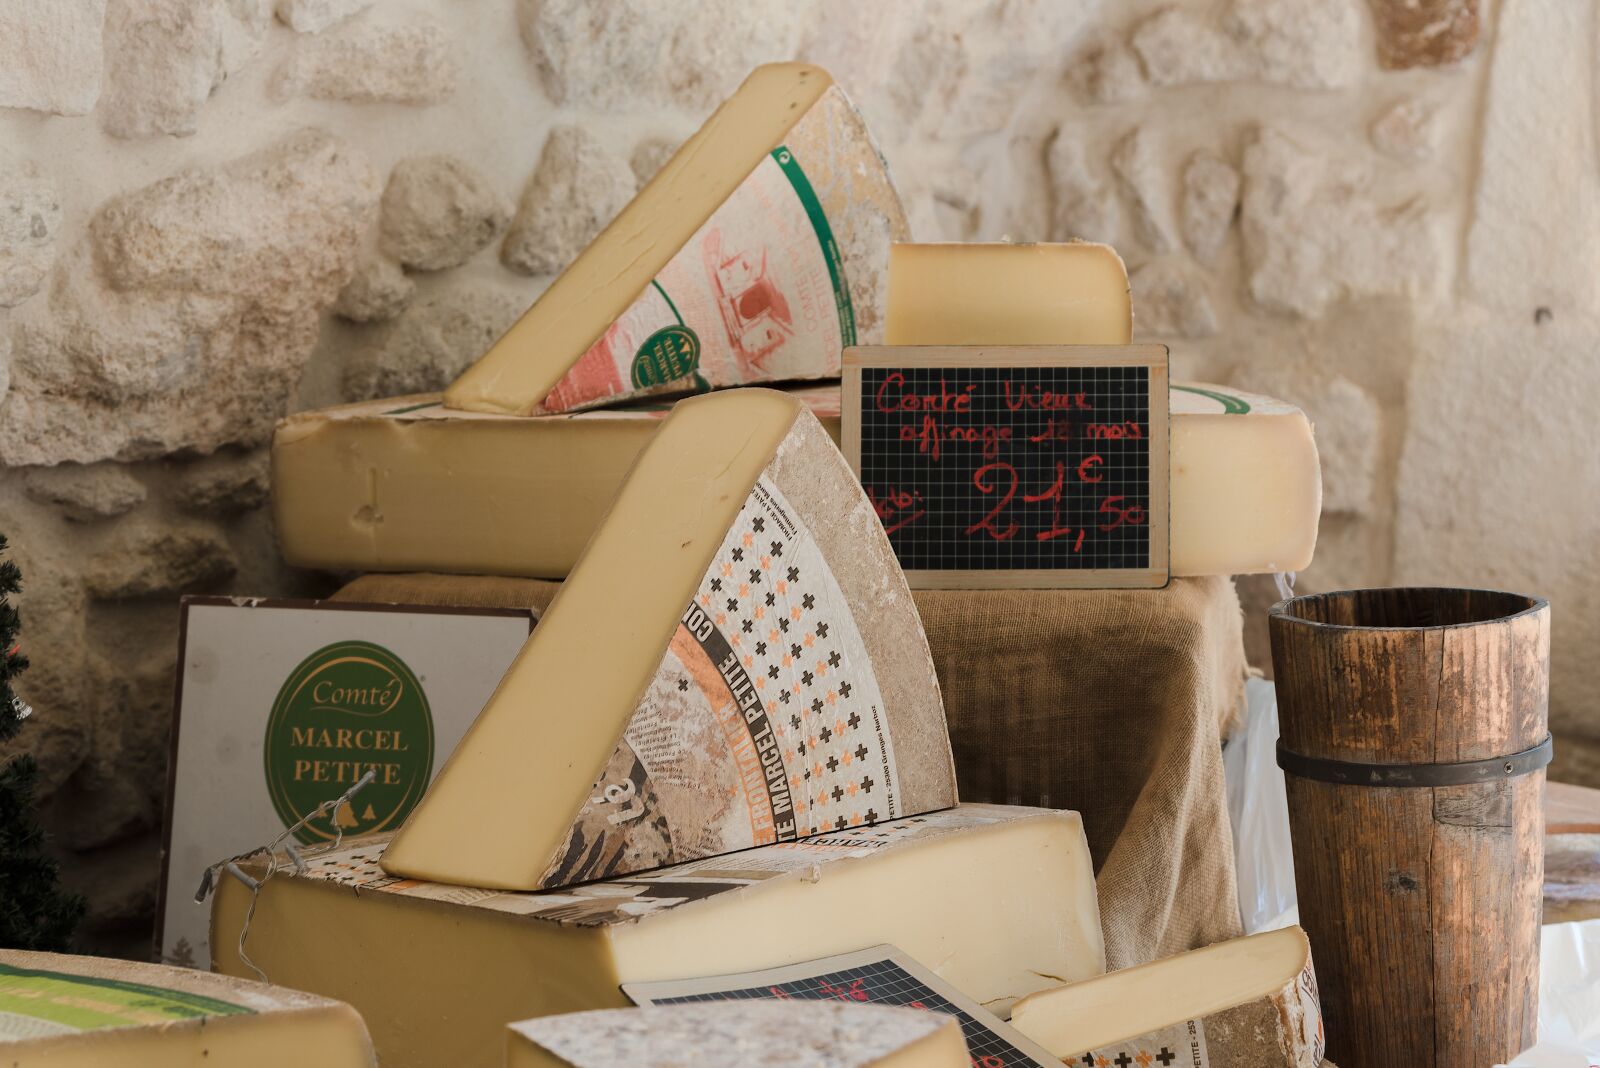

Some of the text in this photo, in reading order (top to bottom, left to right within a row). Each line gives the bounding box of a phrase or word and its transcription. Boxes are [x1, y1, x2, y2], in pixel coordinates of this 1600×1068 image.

[1087, 420, 1142, 441] mois
[312, 678, 402, 706] Comté
[718, 651, 764, 725] PETITE
[871, 704, 882, 732] Narboz
[290, 726, 409, 751] MARCEL
[878, 732, 888, 764] Granges
[293, 759, 402, 785] PETITE
[753, 721, 792, 816] MARCEL
[883, 765, 892, 788] 25300
